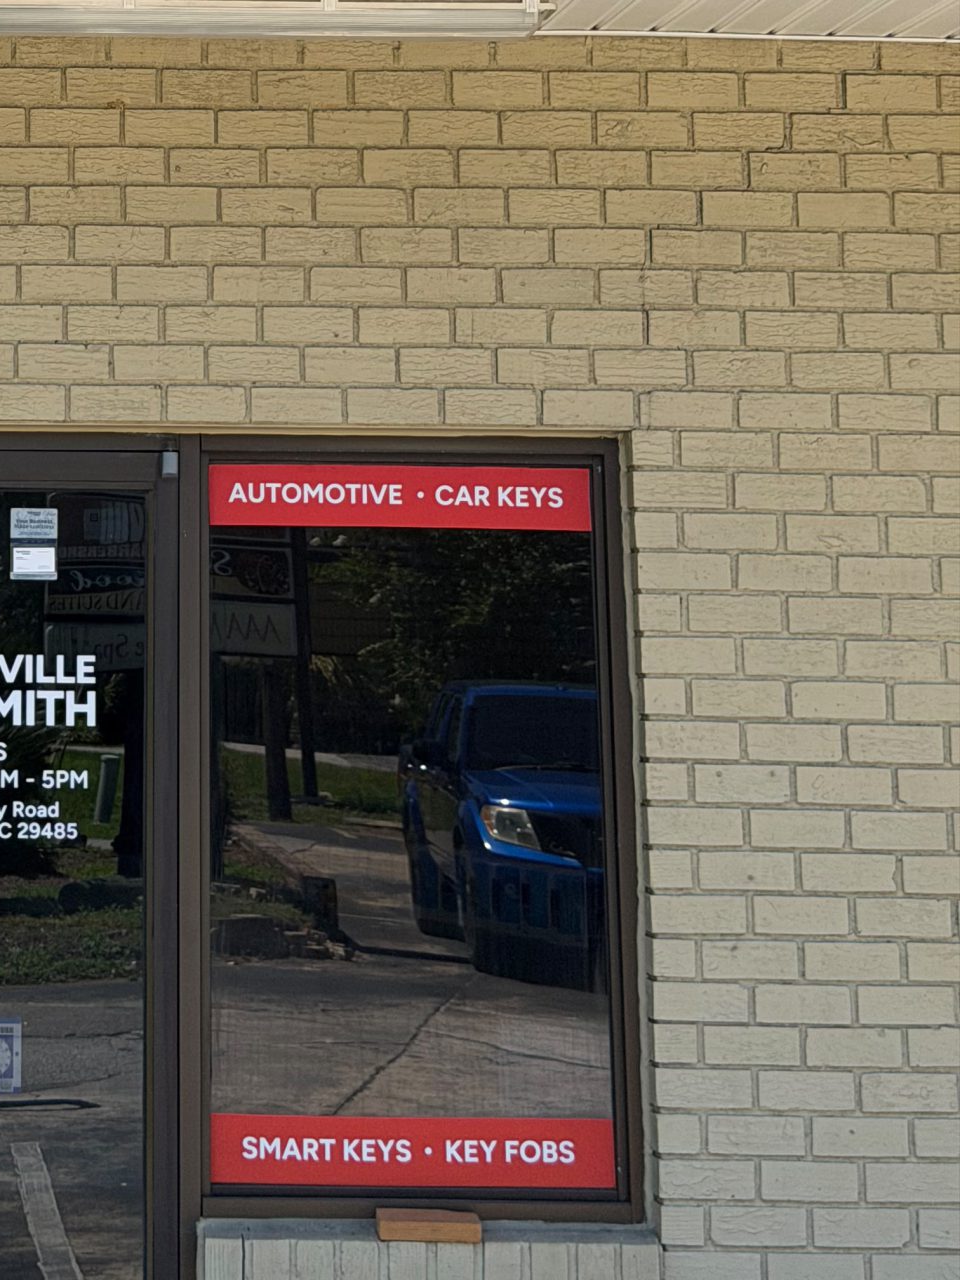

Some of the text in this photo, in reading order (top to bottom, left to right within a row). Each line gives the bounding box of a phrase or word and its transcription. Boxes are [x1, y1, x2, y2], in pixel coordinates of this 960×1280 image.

[228, 482, 564, 508] AUTOMOTIVE CAR KEYS
[41, 770, 88, 789] 5PM
[12, 800, 60, 818] Road
[17, 822, 78, 840] 29485
[242, 1136, 575, 1164] SMART KEYS KEY FOBS
